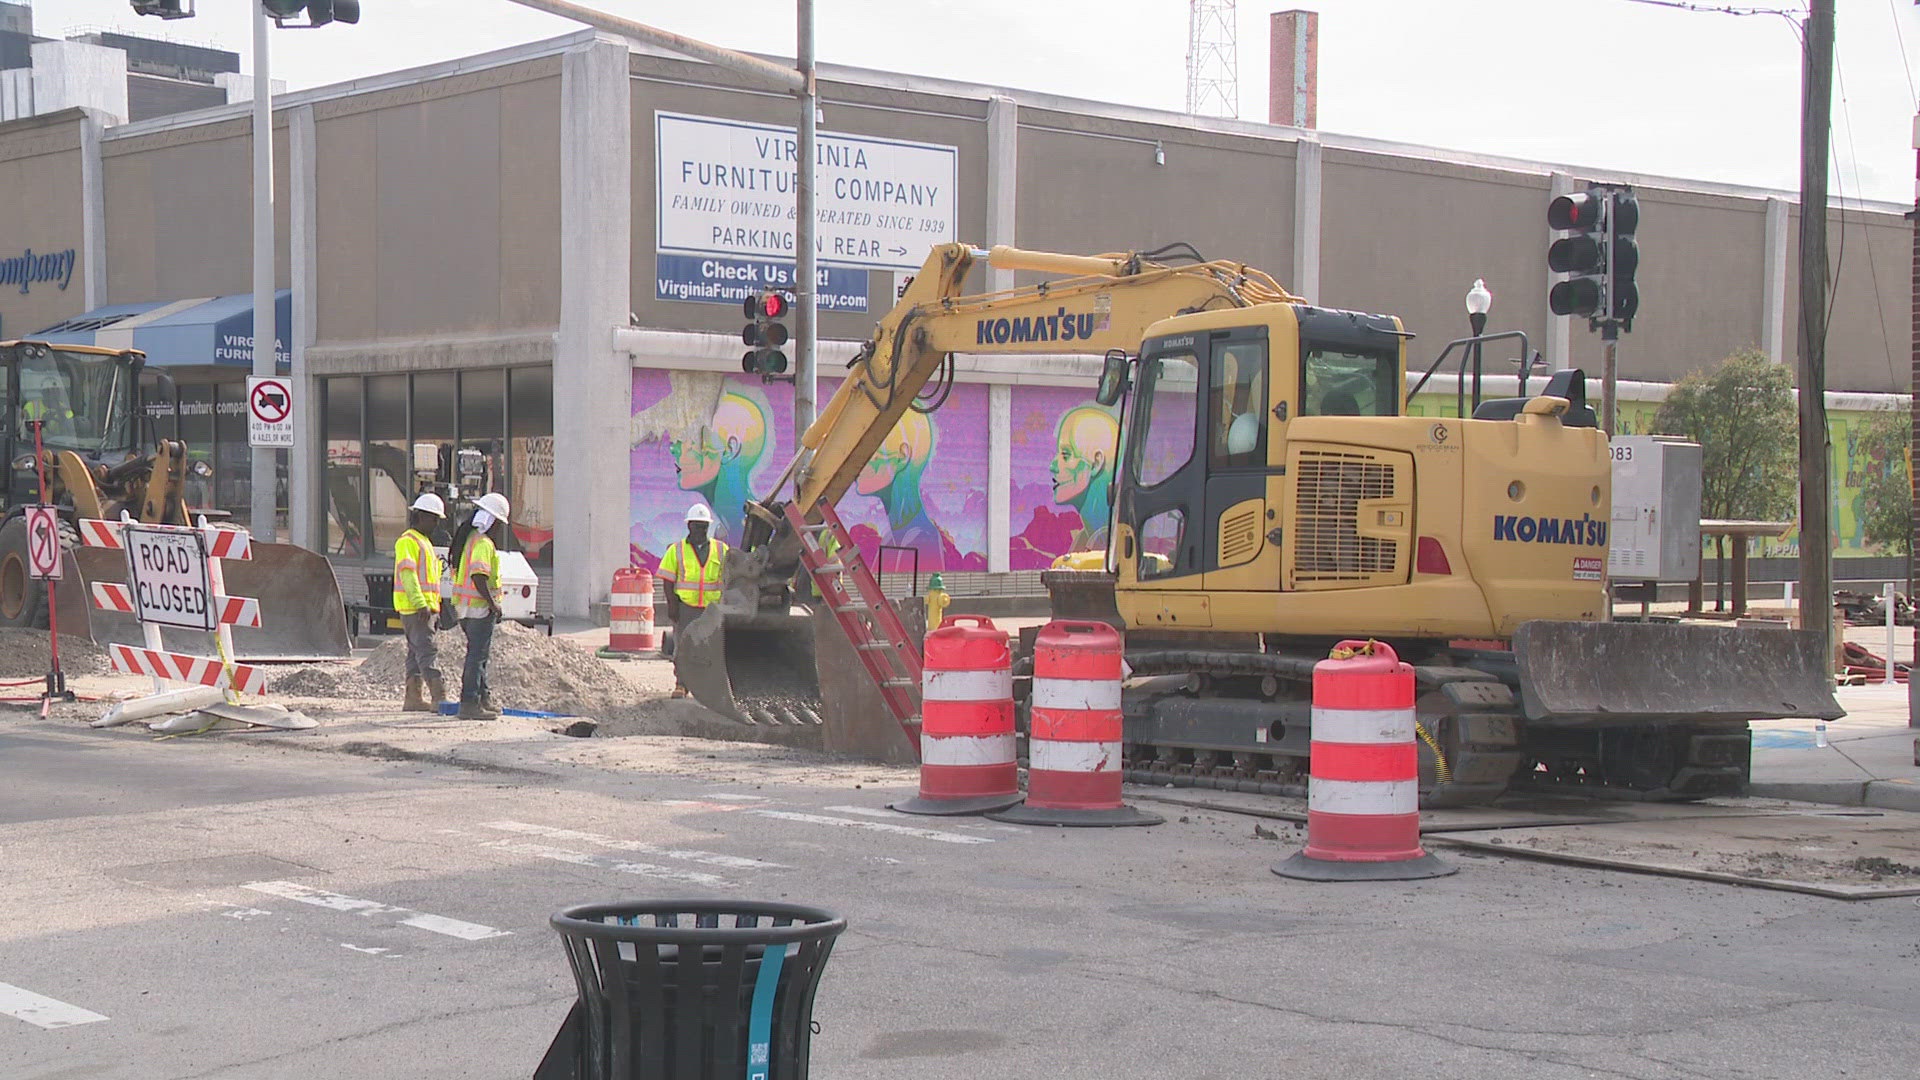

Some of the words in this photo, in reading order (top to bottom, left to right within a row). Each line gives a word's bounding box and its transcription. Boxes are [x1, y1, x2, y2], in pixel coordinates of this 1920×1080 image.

[756, 136, 868, 170] VIRINIA
[834, 177, 938, 207] COMPANY
[672, 195, 726, 213] FAMILY
[730, 200, 781, 218] OWNED
[876, 215, 914, 231] SINCE
[918, 219, 945, 234] 1939
[712, 226, 794, 250] PARKING
[834, 236, 881, 258] REAR
[701, 260, 758, 281] Check
[764, 264, 788, 283] Us
[223, 335, 283, 350] VIRGA
[145, 401, 174, 419] virginia
[179, 400, 213, 415] furniture
[216, 402, 248, 417] compan
[140, 543, 190, 574] ROAD
[1580, 559, 1602, 570] DANGER
[139, 581, 206, 615] CLOSED
